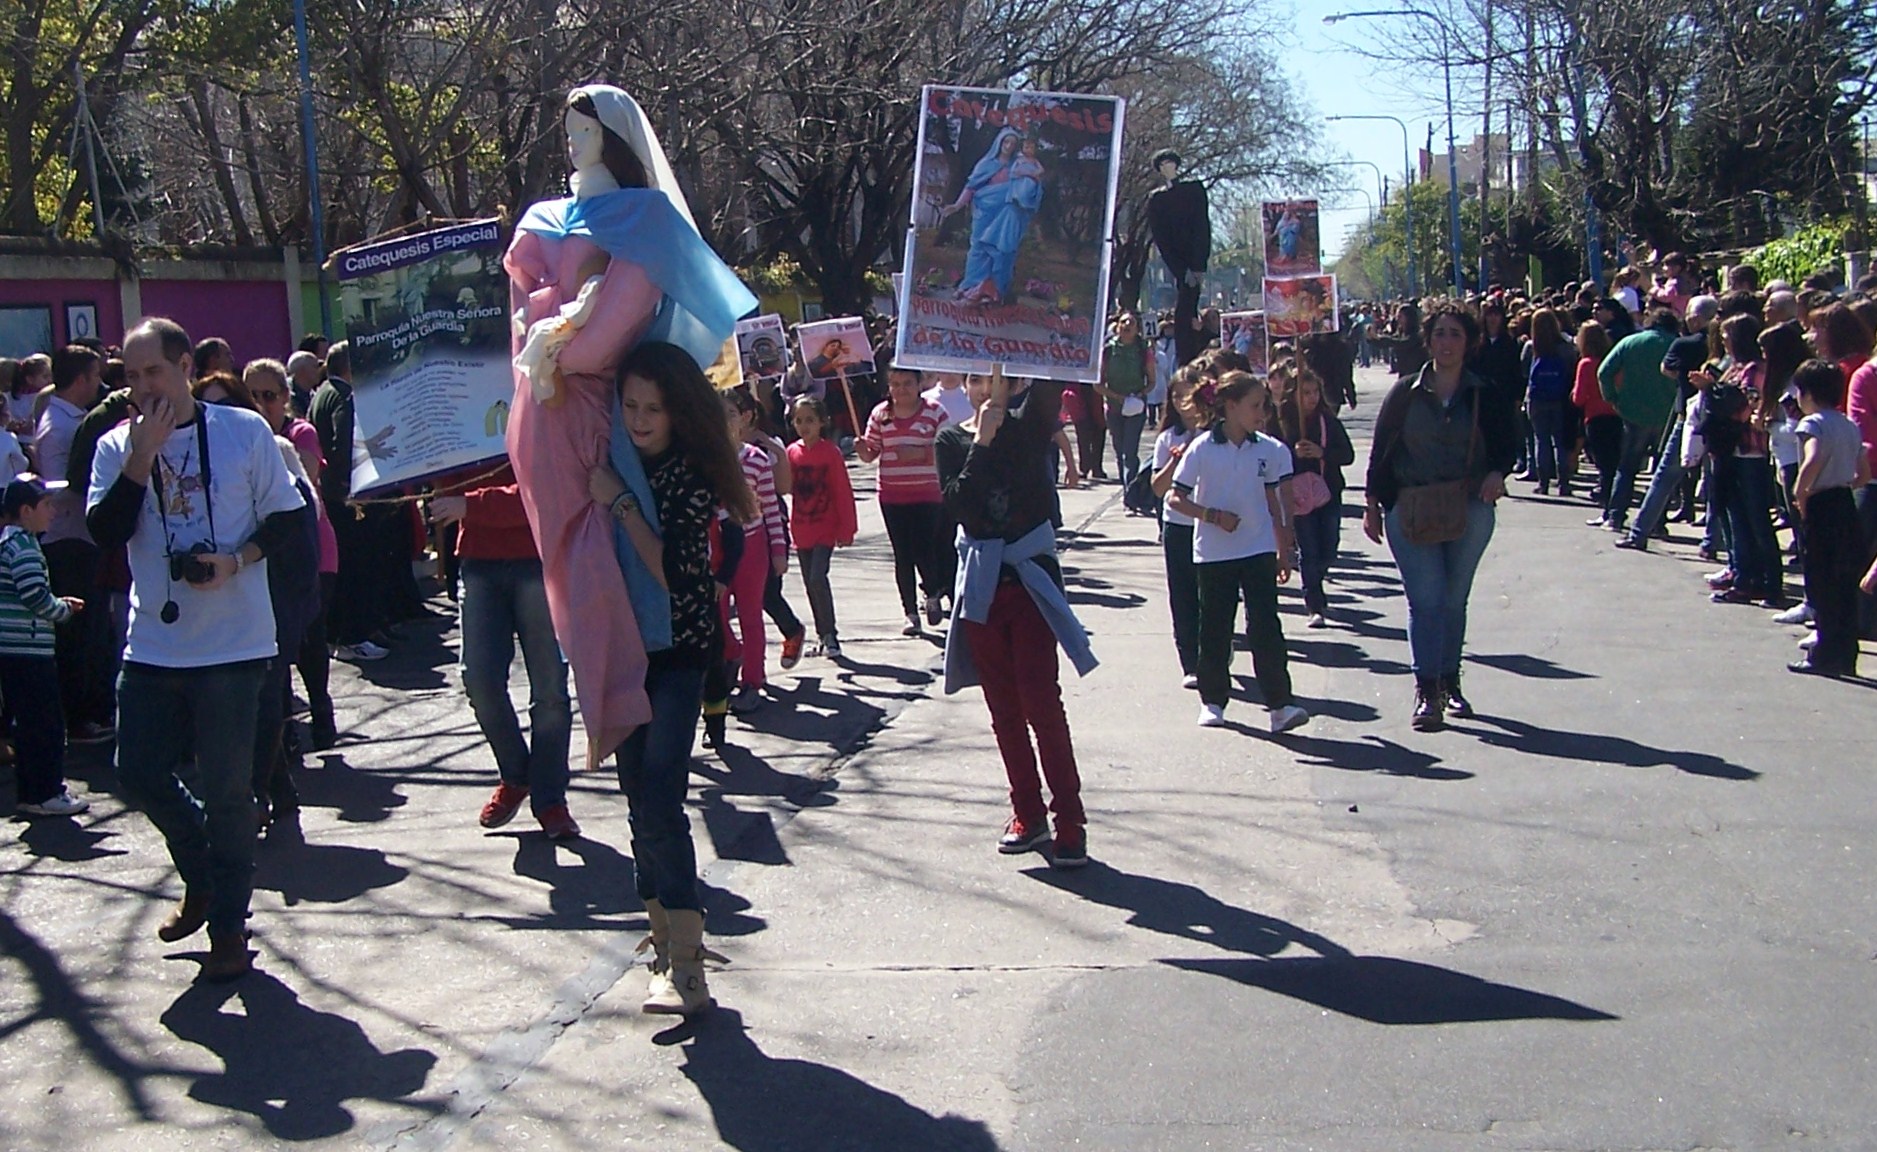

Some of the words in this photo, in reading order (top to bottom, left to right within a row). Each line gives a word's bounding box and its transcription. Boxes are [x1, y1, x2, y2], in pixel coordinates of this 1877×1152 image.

[928, 90, 1113, 134] Catequesis
[346, 241, 430, 272] Catequesis
[432, 226, 498, 250] Especial
[356, 321, 411, 347] Parroquia
[411, 308, 455, 327] Nuestra
[419, 320, 465, 337] Guardia
[911, 295, 980, 328] Parroquia
[912, 326, 943, 346] de
[949, 330, 976, 352] la
[982, 335, 1090, 361] Guardia
